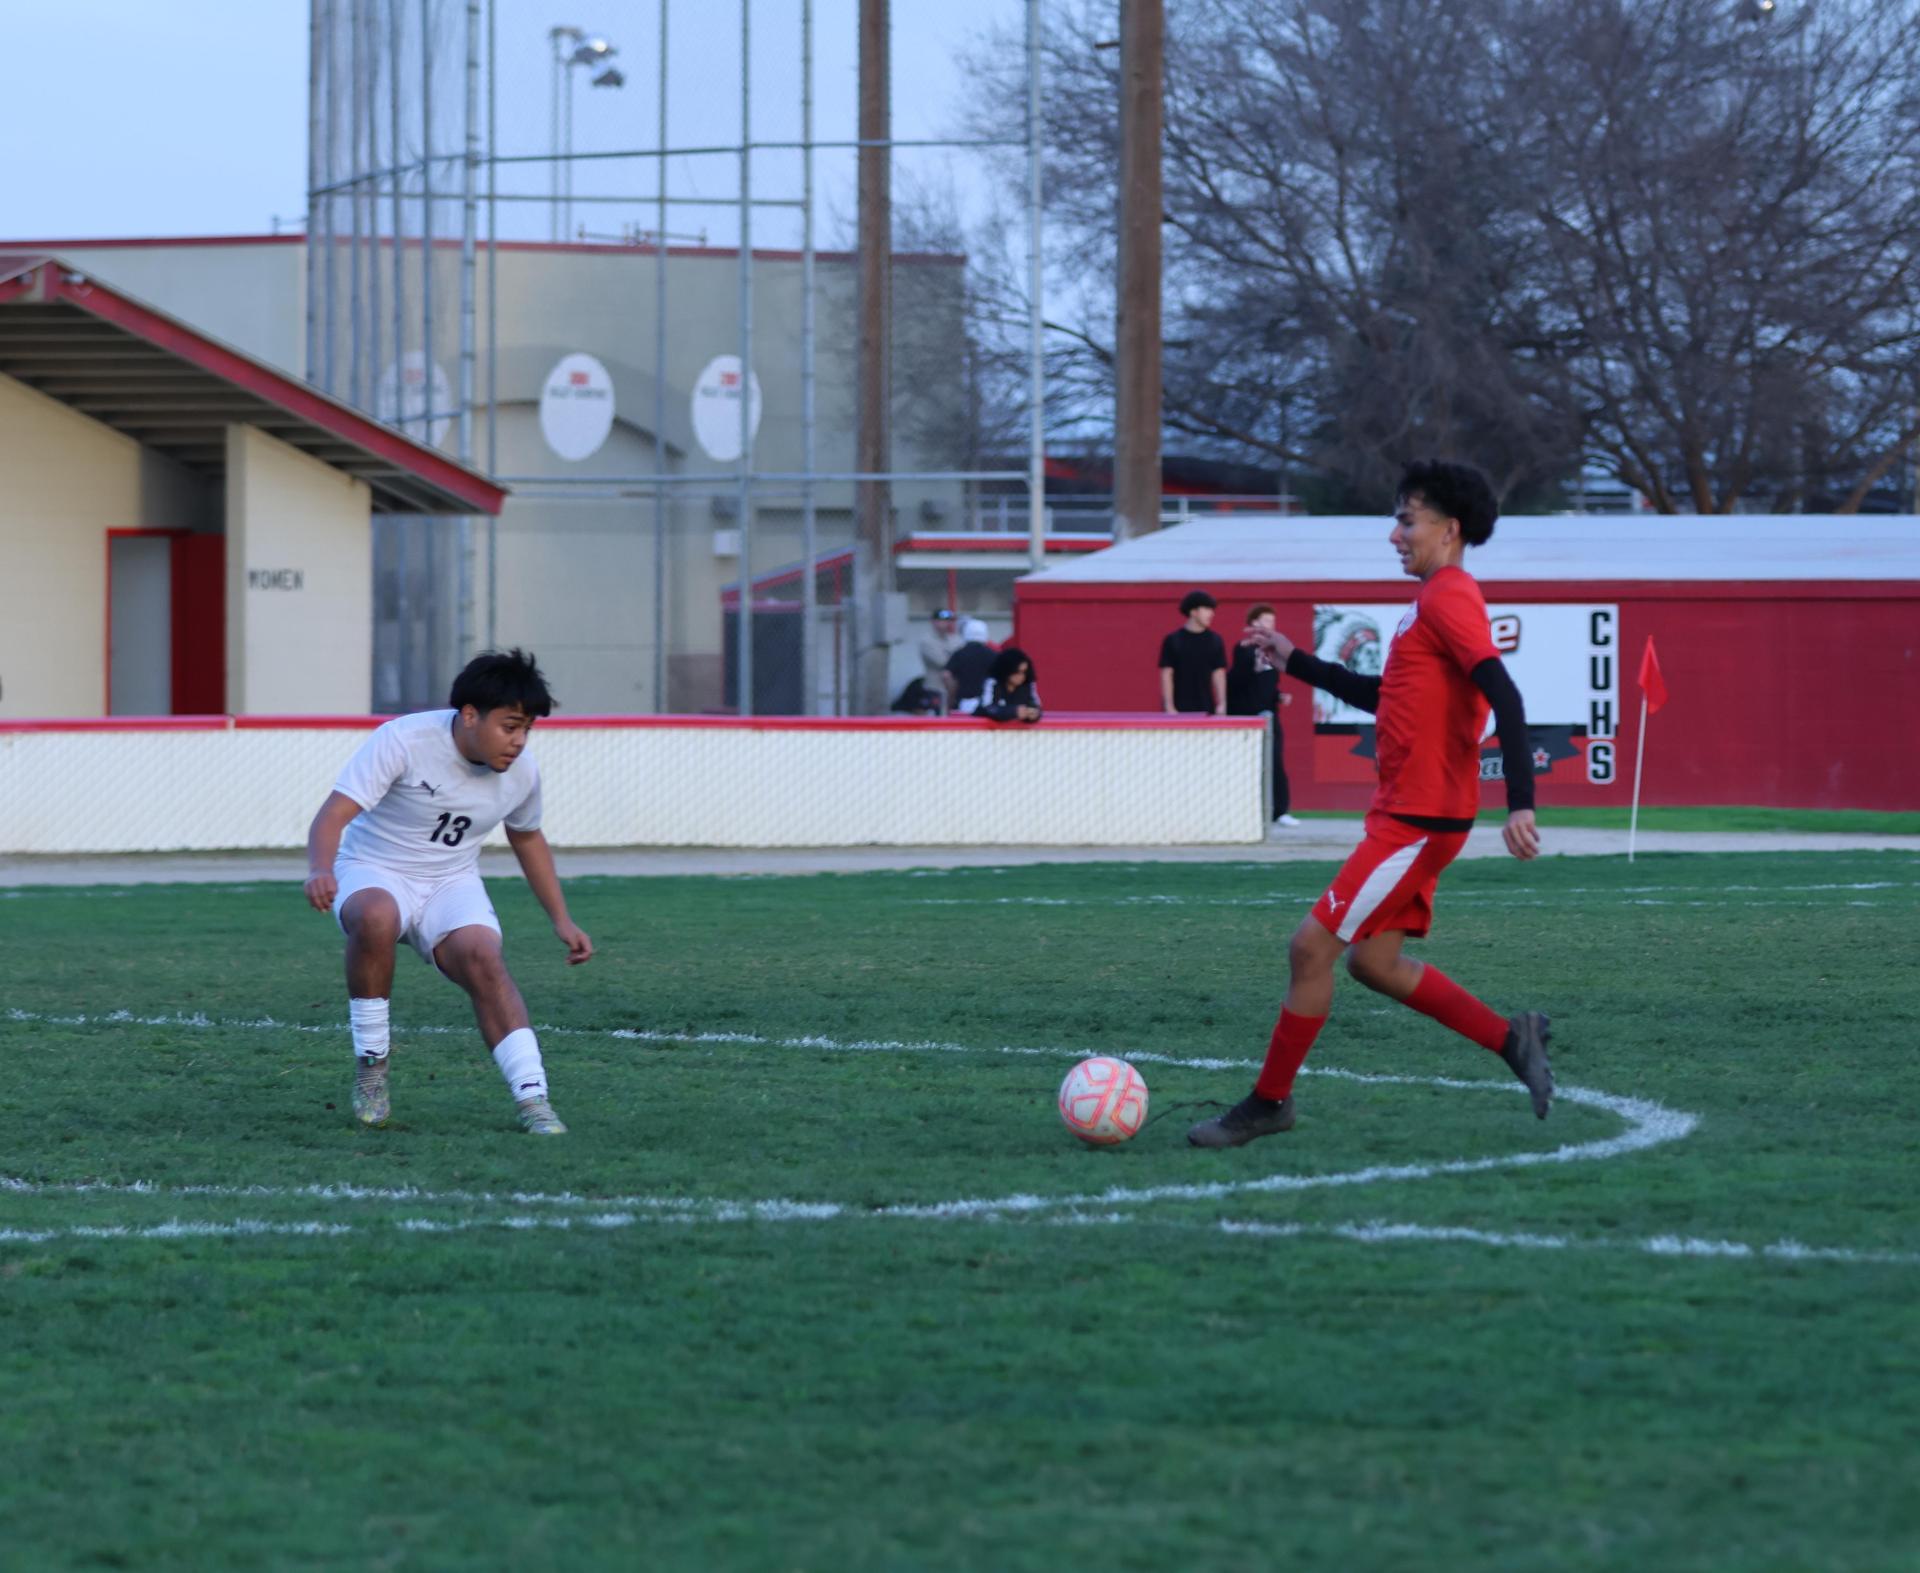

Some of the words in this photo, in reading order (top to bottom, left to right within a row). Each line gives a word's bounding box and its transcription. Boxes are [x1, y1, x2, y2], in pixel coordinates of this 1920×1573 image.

[249, 568, 303, 591] WOMEN
[1590, 610, 1612, 780] CUHS
[430, 812, 472, 847] 13
